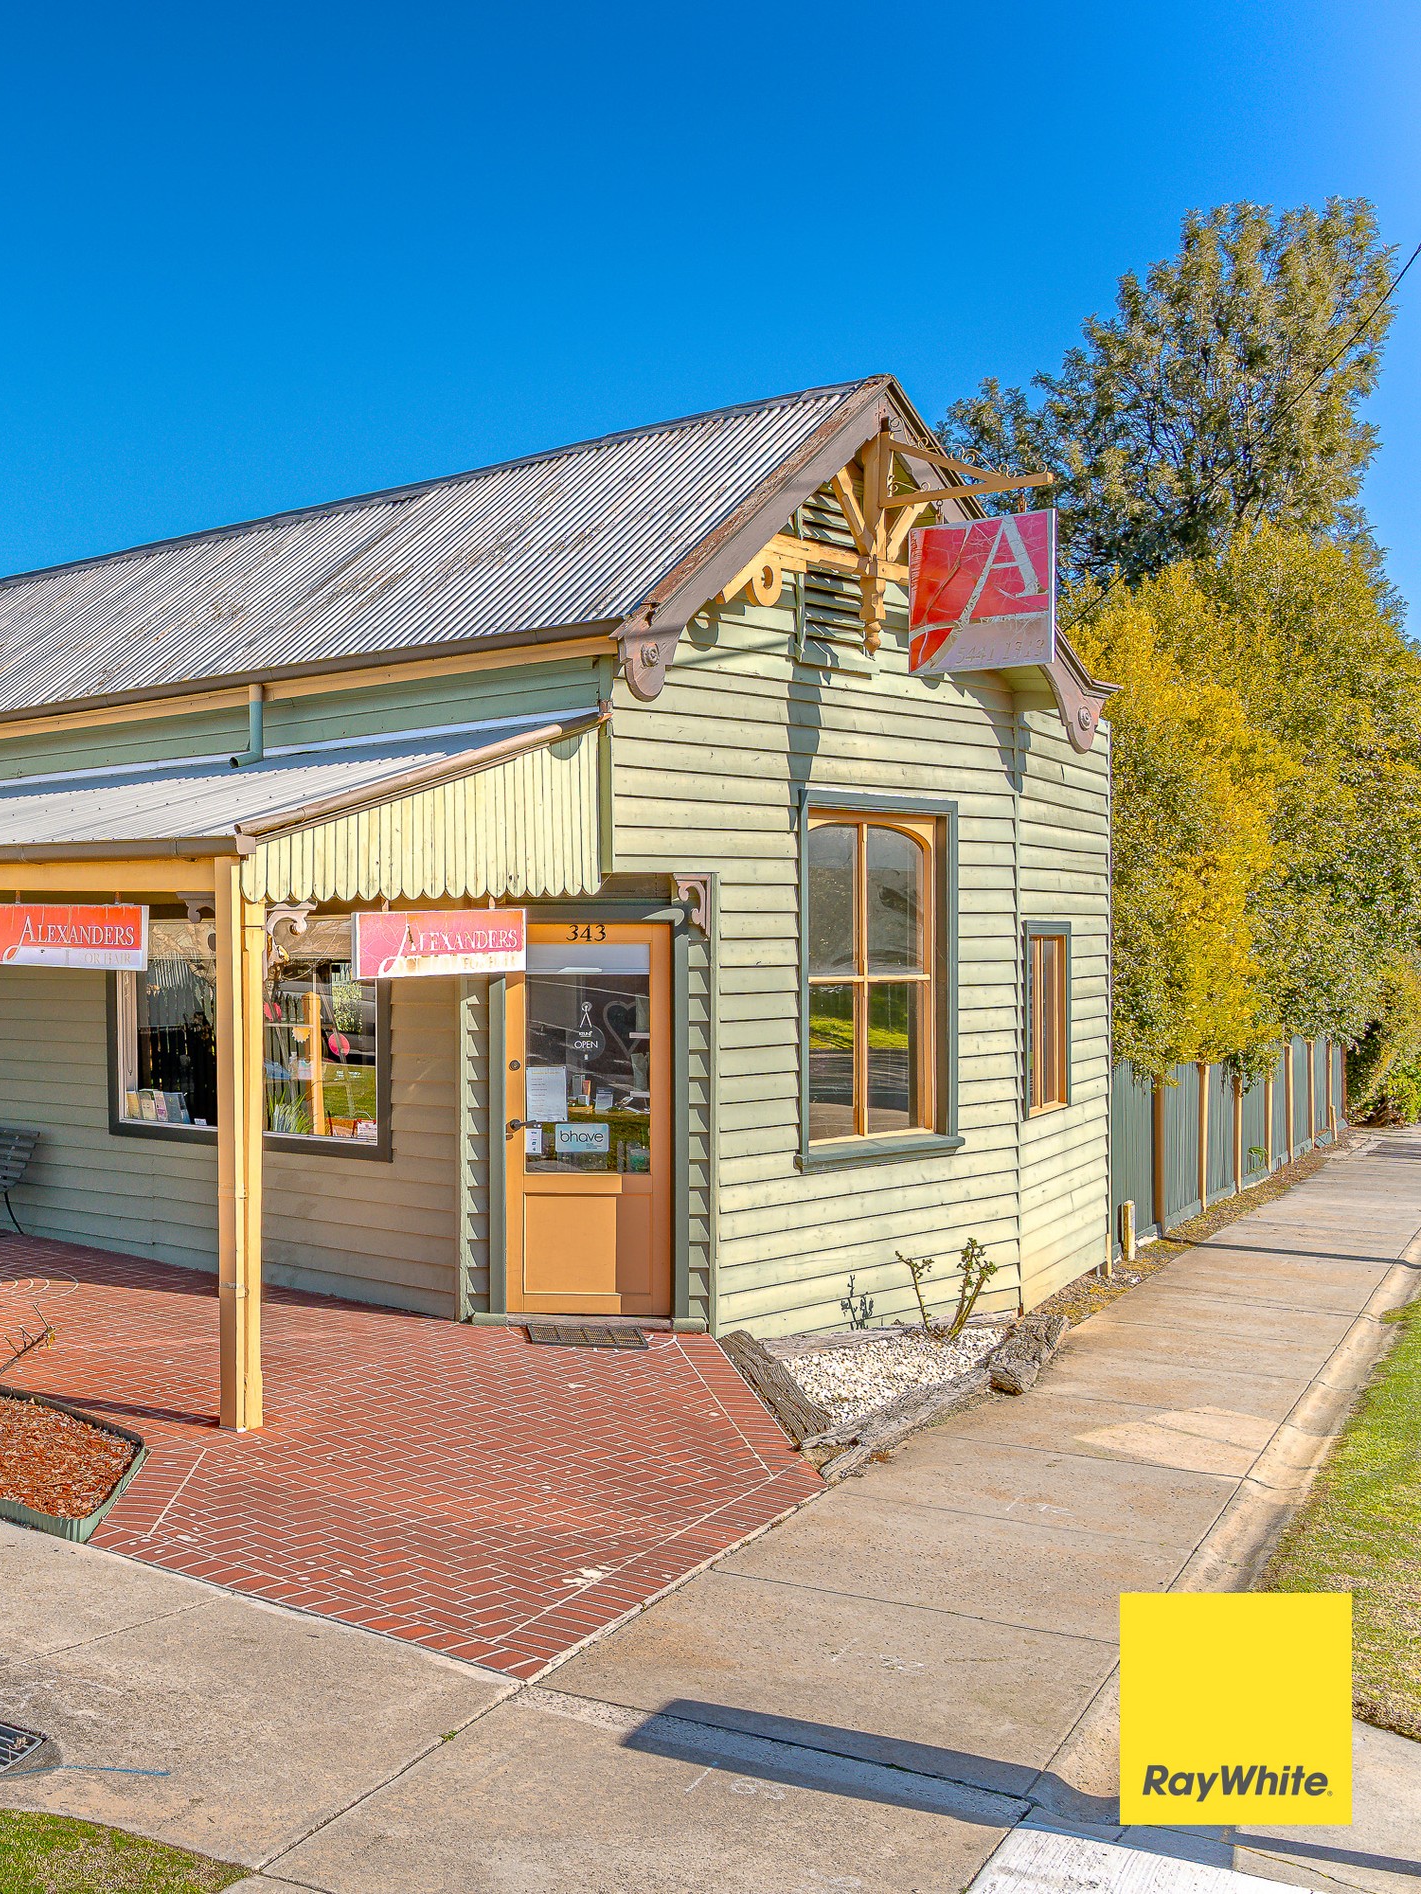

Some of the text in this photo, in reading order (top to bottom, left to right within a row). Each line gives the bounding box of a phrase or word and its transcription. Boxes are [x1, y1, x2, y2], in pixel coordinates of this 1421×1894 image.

[566, 923, 607, 942] 343
[574, 1040, 598, 1049] OPEN
[560, 1130, 604, 1143] bhave
